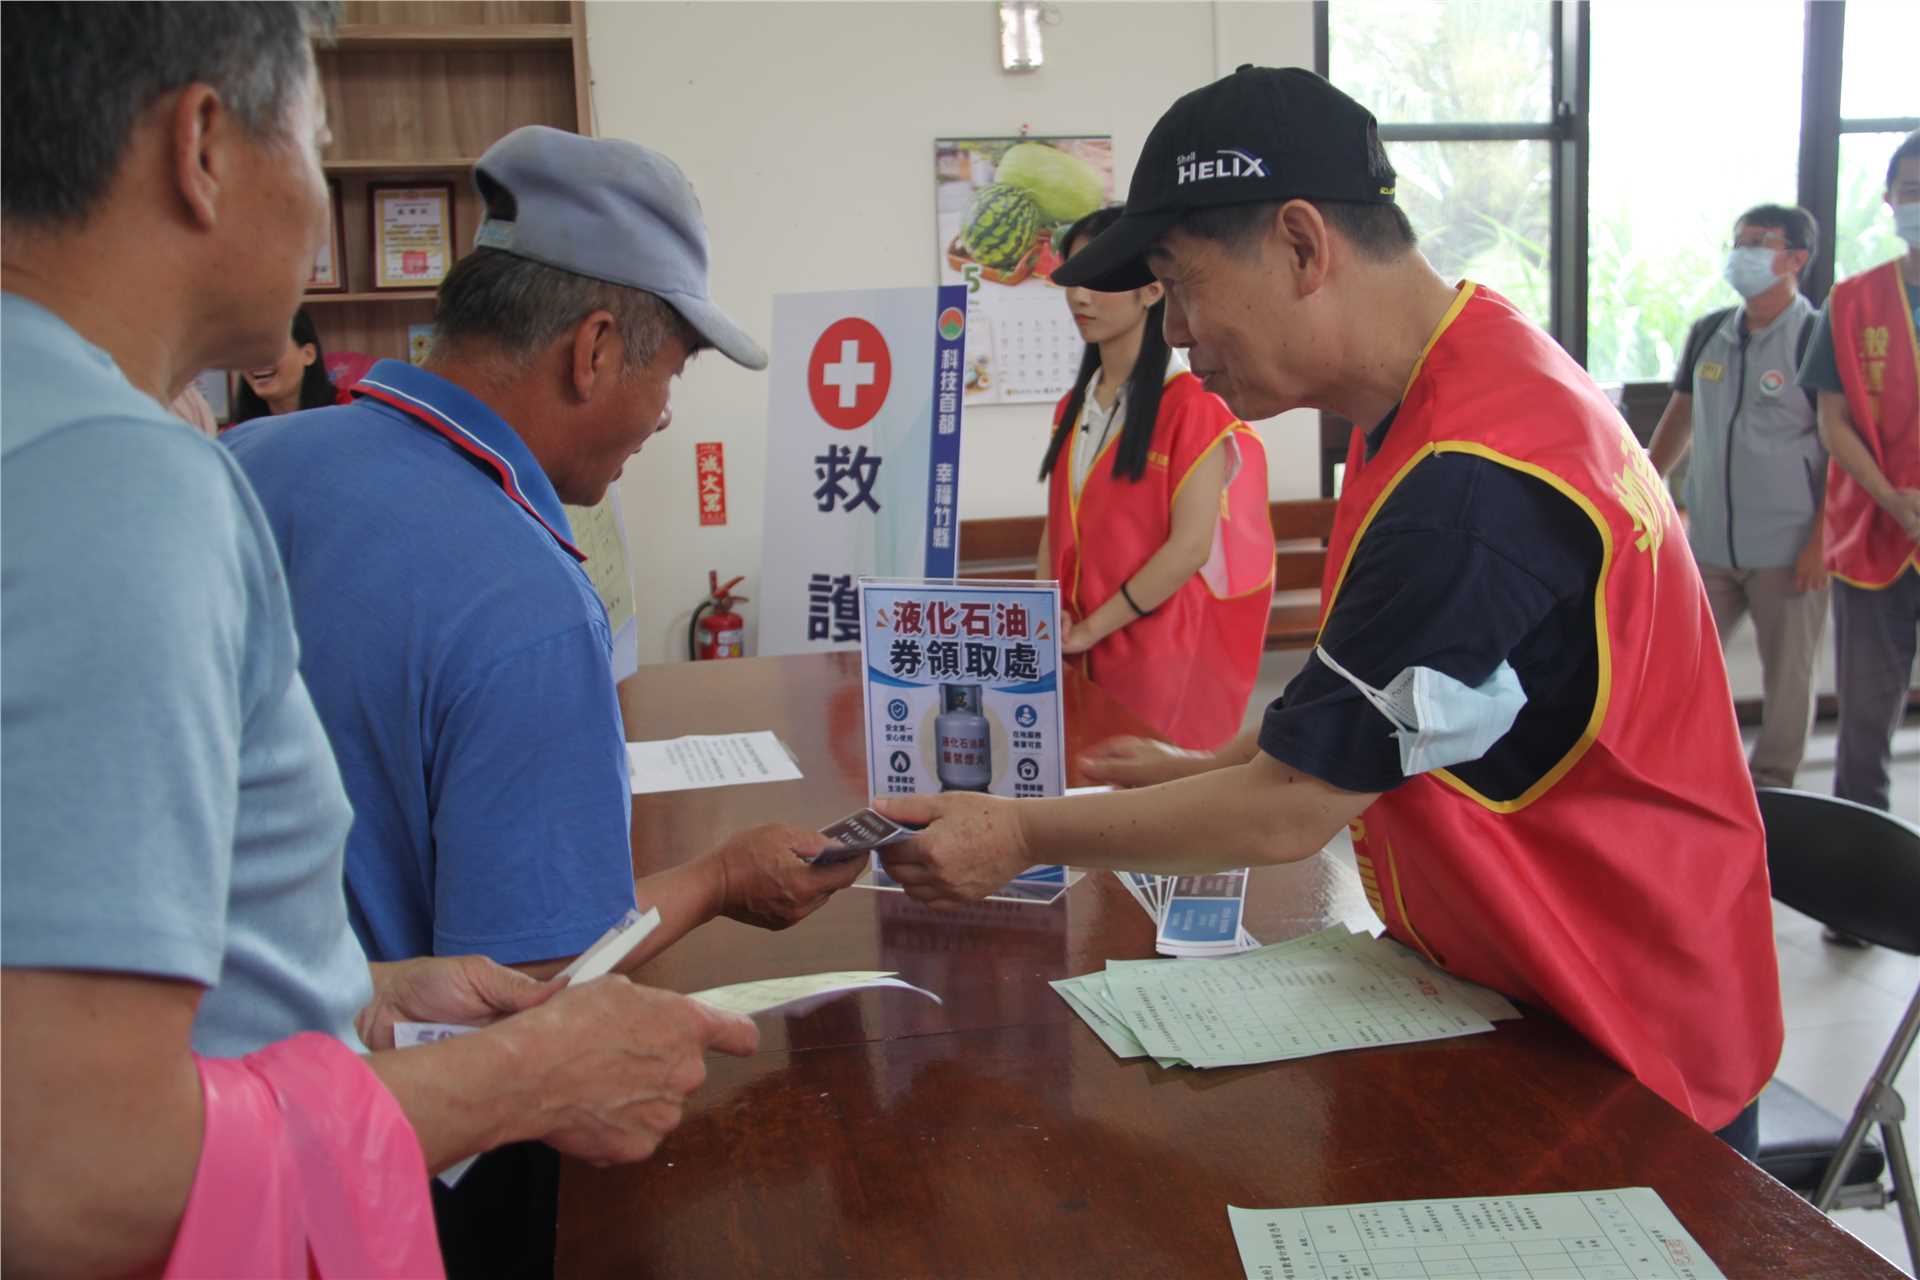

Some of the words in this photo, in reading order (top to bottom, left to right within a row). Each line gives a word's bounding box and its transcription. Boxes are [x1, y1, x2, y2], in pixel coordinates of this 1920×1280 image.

[1178, 155, 1266, 185] HELIX
[963, 265, 981, 293] 5
[938, 348, 960, 434] 科技首都
[932, 463, 953, 548] 幸福竹縣
[892, 601, 1028, 637] 液化石油
[889, 640, 1038, 679] 券領取處
